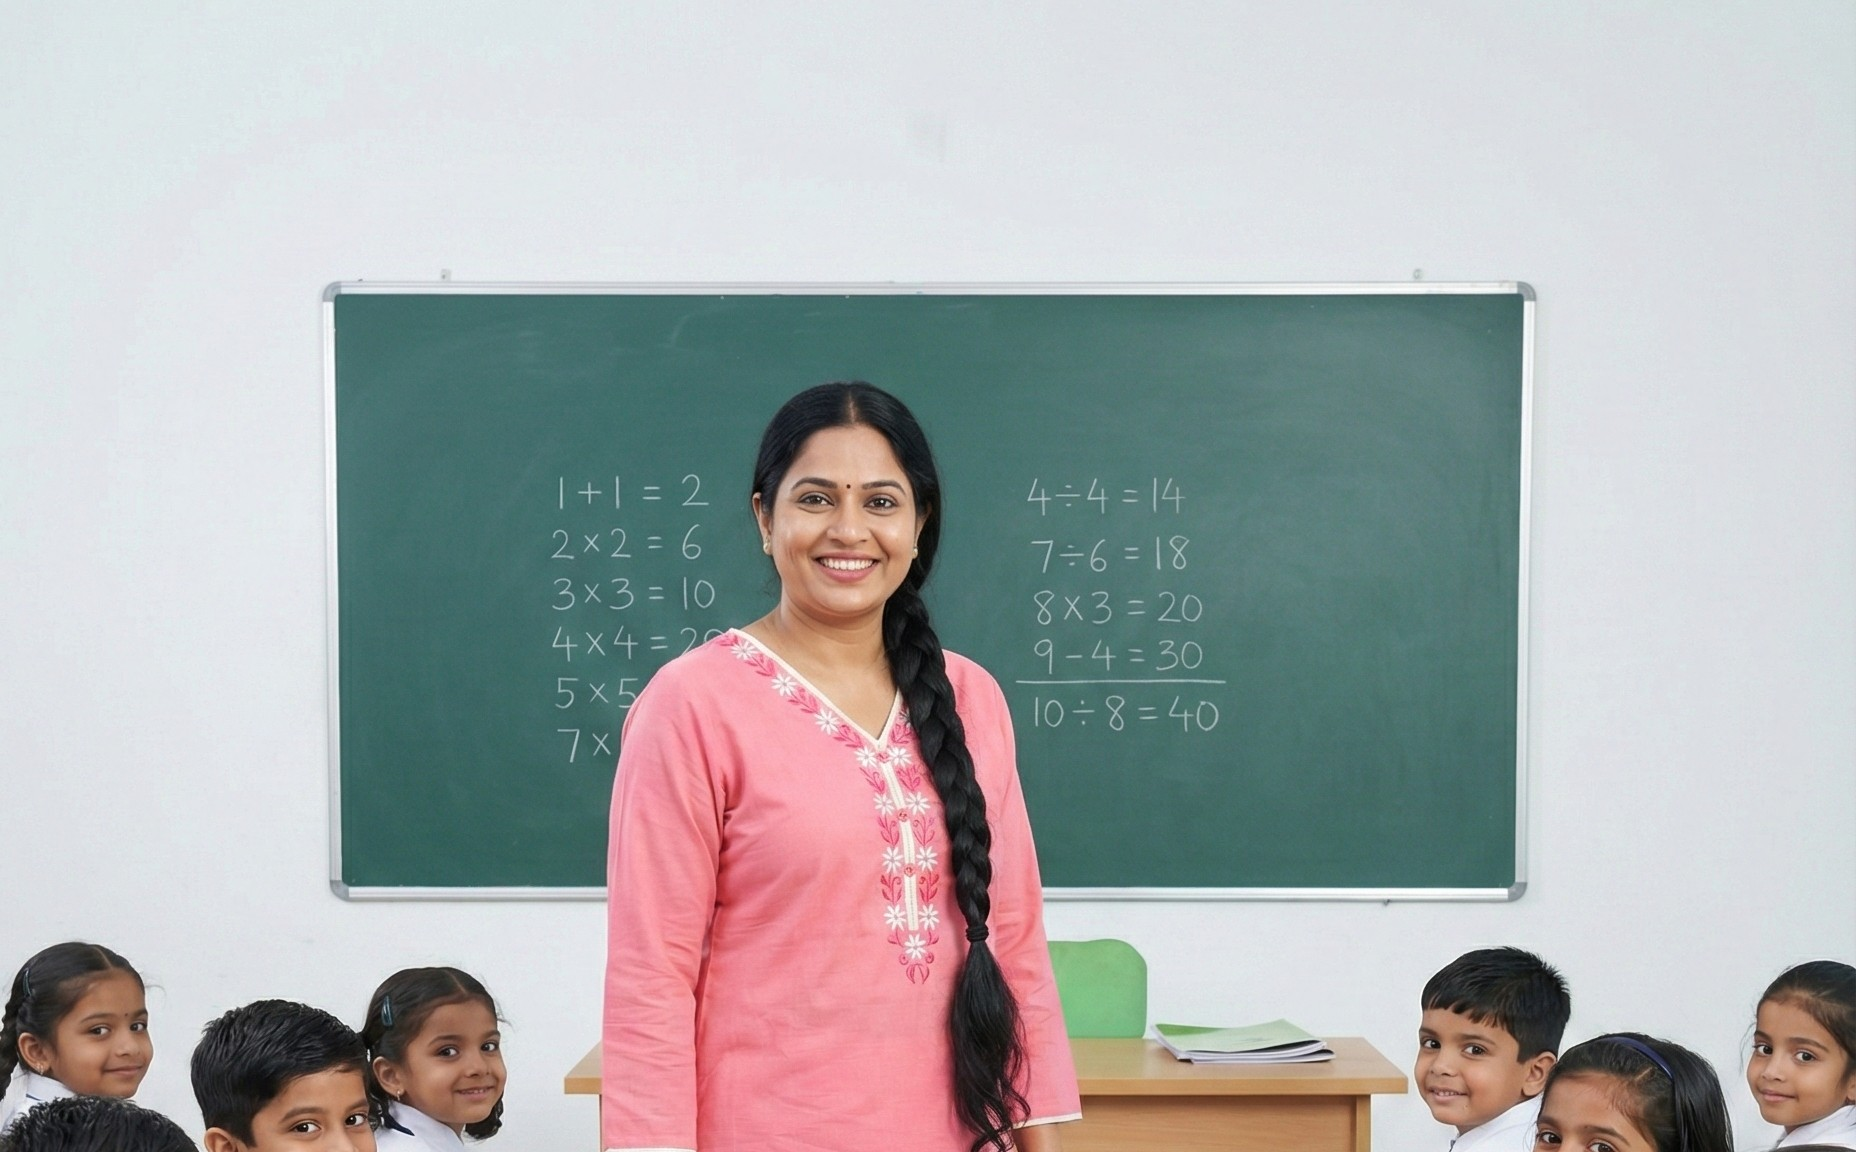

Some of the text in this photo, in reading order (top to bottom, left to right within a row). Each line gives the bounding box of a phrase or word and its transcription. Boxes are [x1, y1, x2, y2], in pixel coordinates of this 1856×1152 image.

[681, 474, 709, 506] 2
[1153, 477, 1186, 514] 14
[682, 524, 701, 560] 6
[1156, 535, 1190, 570] 18
[683, 576, 715, 610] 10
[1157, 591, 1202, 622] 20
[680, 627, 725, 656] 2
[1156, 640, 1203, 671] 30
[1168, 696, 1219, 732] 40
